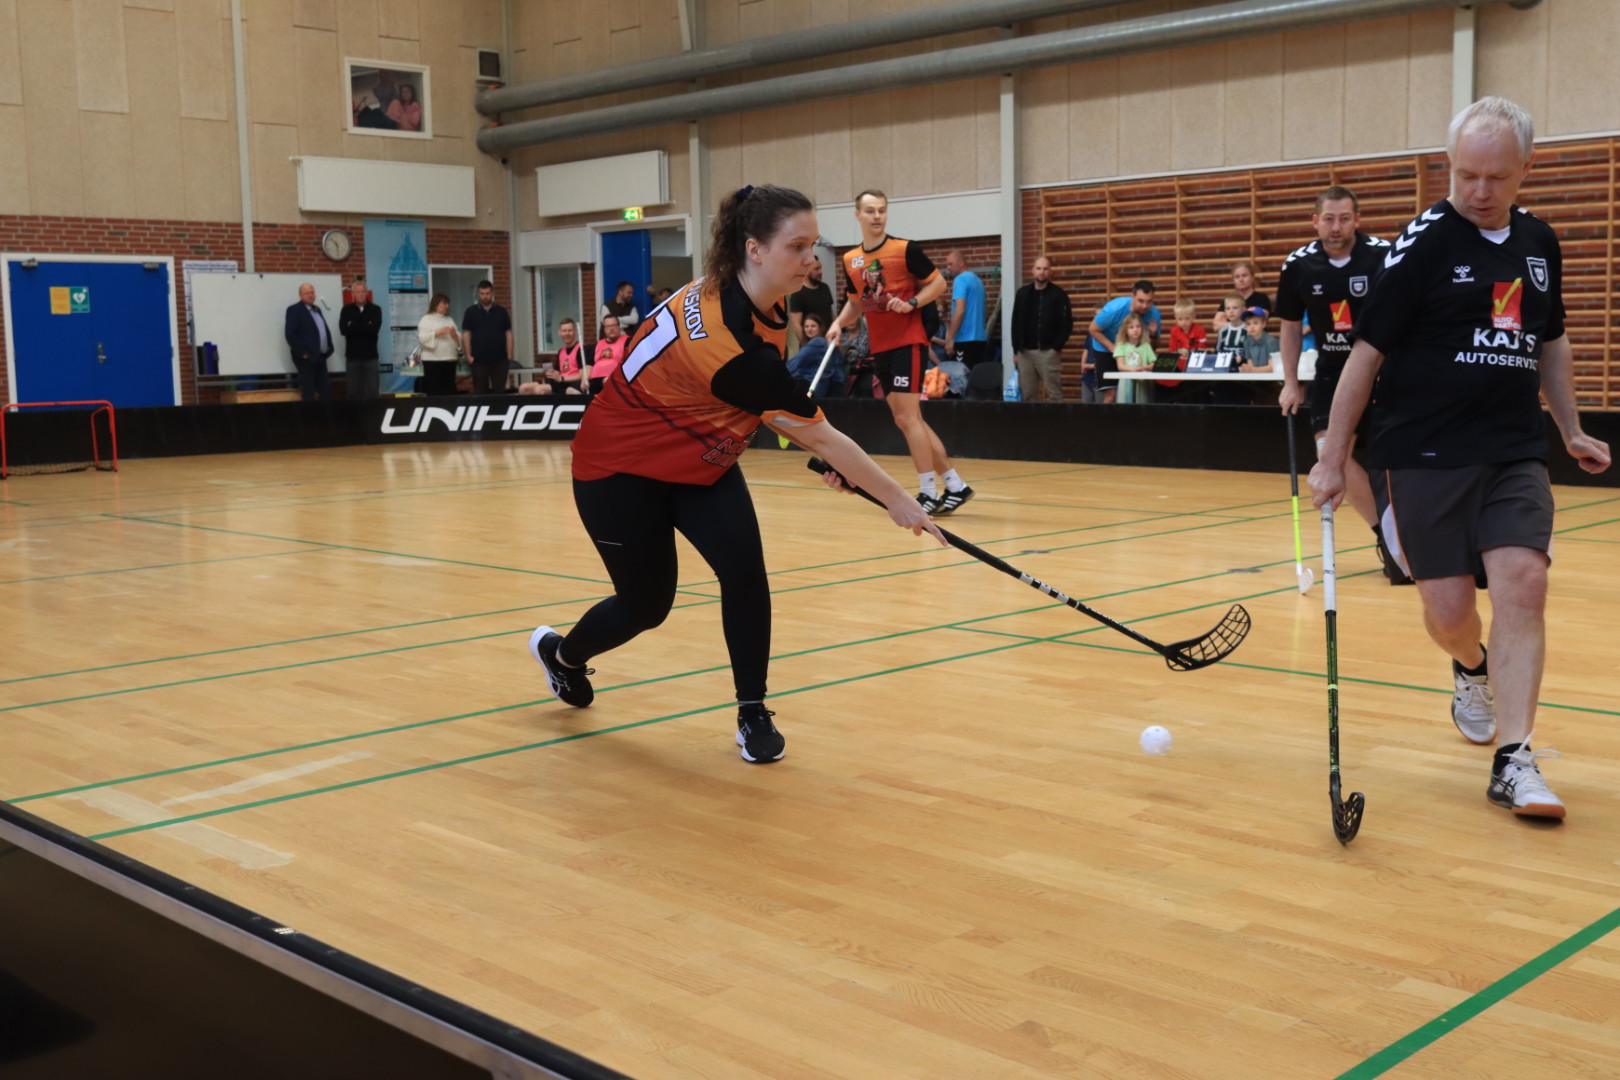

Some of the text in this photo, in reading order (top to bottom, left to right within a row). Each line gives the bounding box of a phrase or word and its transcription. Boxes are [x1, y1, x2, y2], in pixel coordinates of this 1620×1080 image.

[851, 256, 864, 269] 05
[1325, 332, 1350, 344] KA
[1473, 327, 1537, 353] KAJ'S
[893, 376, 910, 387] 05
[380, 404, 586, 434] UNIHOC
